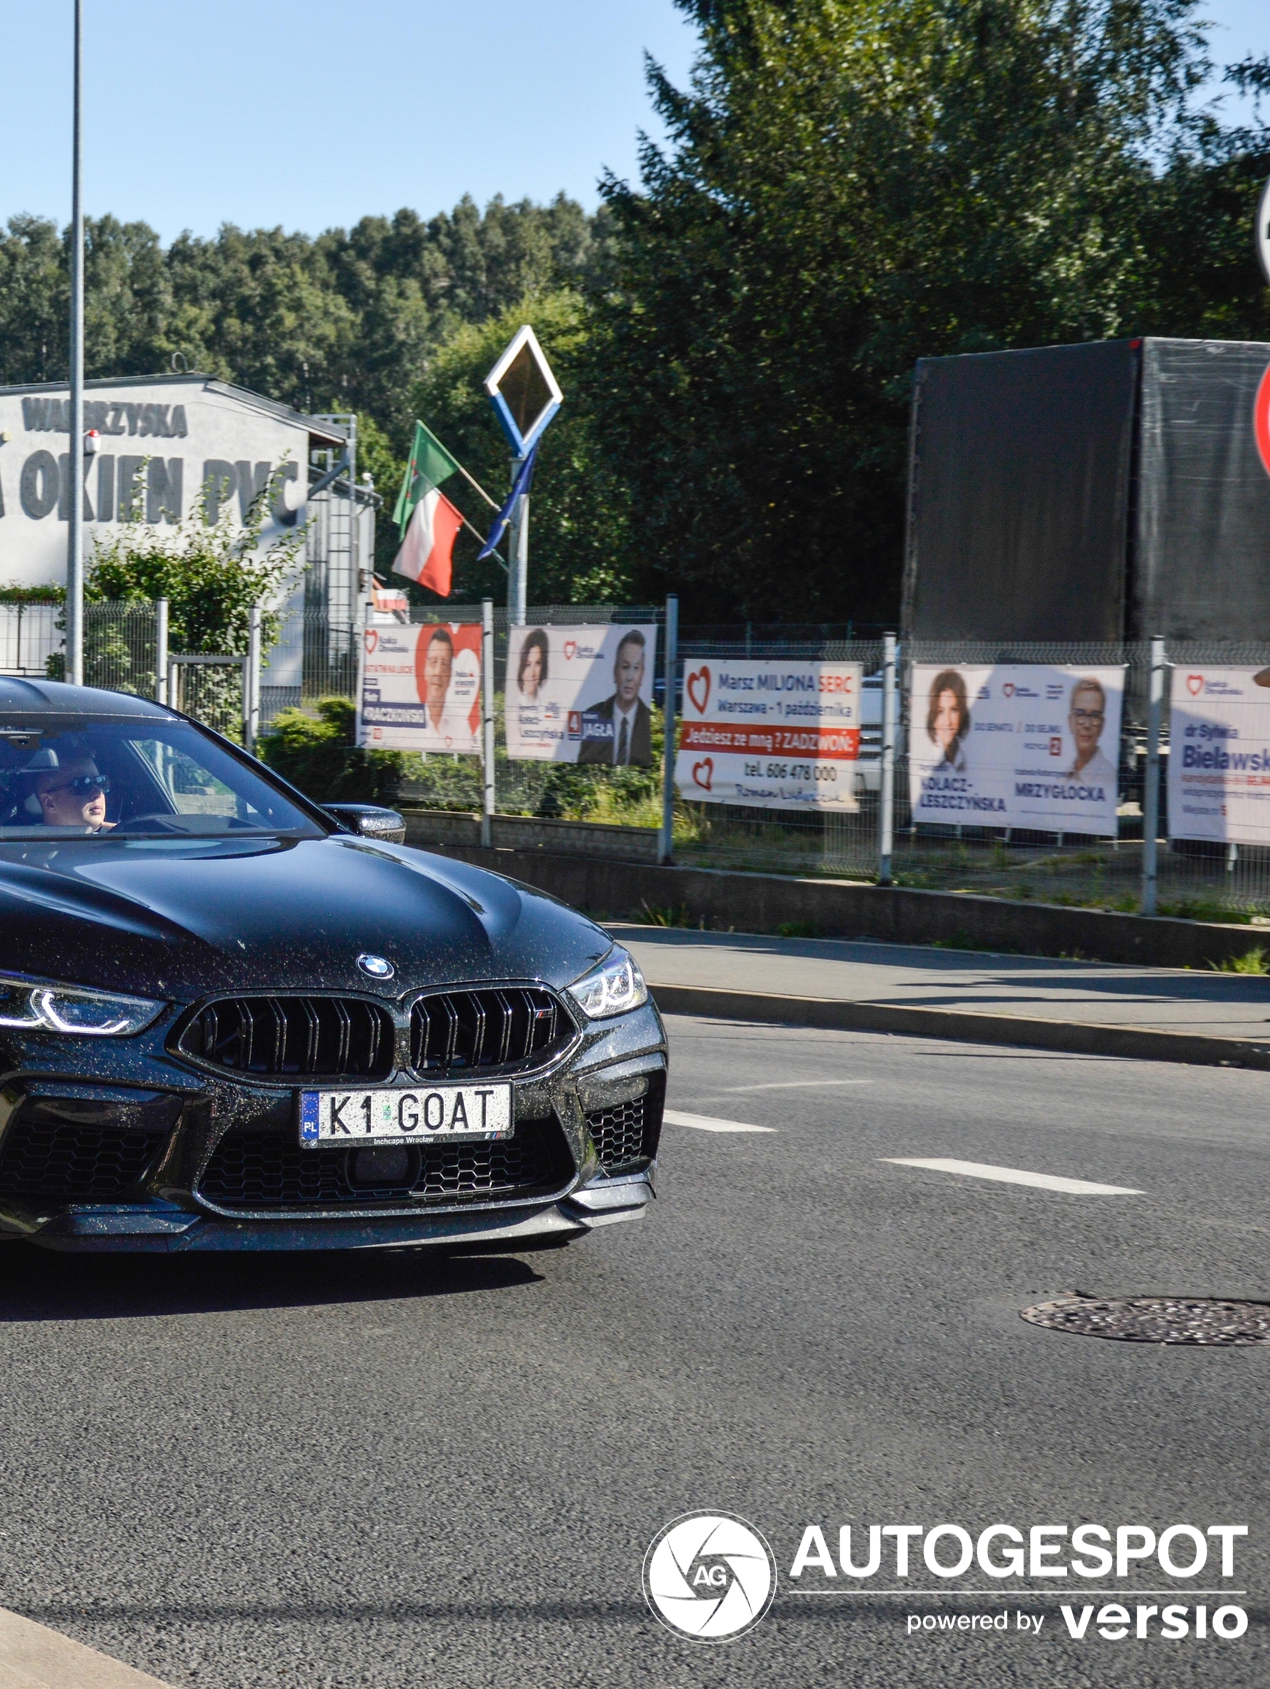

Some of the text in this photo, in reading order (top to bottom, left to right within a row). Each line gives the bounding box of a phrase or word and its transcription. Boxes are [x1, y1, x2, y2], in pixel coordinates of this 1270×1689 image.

[20, 449, 184, 525] OKIEN
[203, 459, 299, 528] PVC
[718, 673, 853, 693] Marsz MILIONA SERC
[718, 699, 767, 715] Warszawa
[776, 701, 783, 715] 1
[785, 700, 852, 718] października
[570, 714, 578, 731] 4
[1185, 724, 1238, 741] dr Sylwia
[686, 727, 732, 746] Jedziesz
[733, 733, 747, 746] ze
[749, 734, 773, 752] mną
[1052, 740, 1060, 753] 2
[744, 761, 838, 781] tel. 606 478 000
[920, 792, 1007, 812] LESZCZYŃSKA
[1015, 782, 1106, 802] MRZYGŁOCKA
[330, 1089, 494, 1135] K1 GOAT
[304, 1122, 317, 1132] PL
[373, 1135, 434, 1145] Inchcape Wrocław
